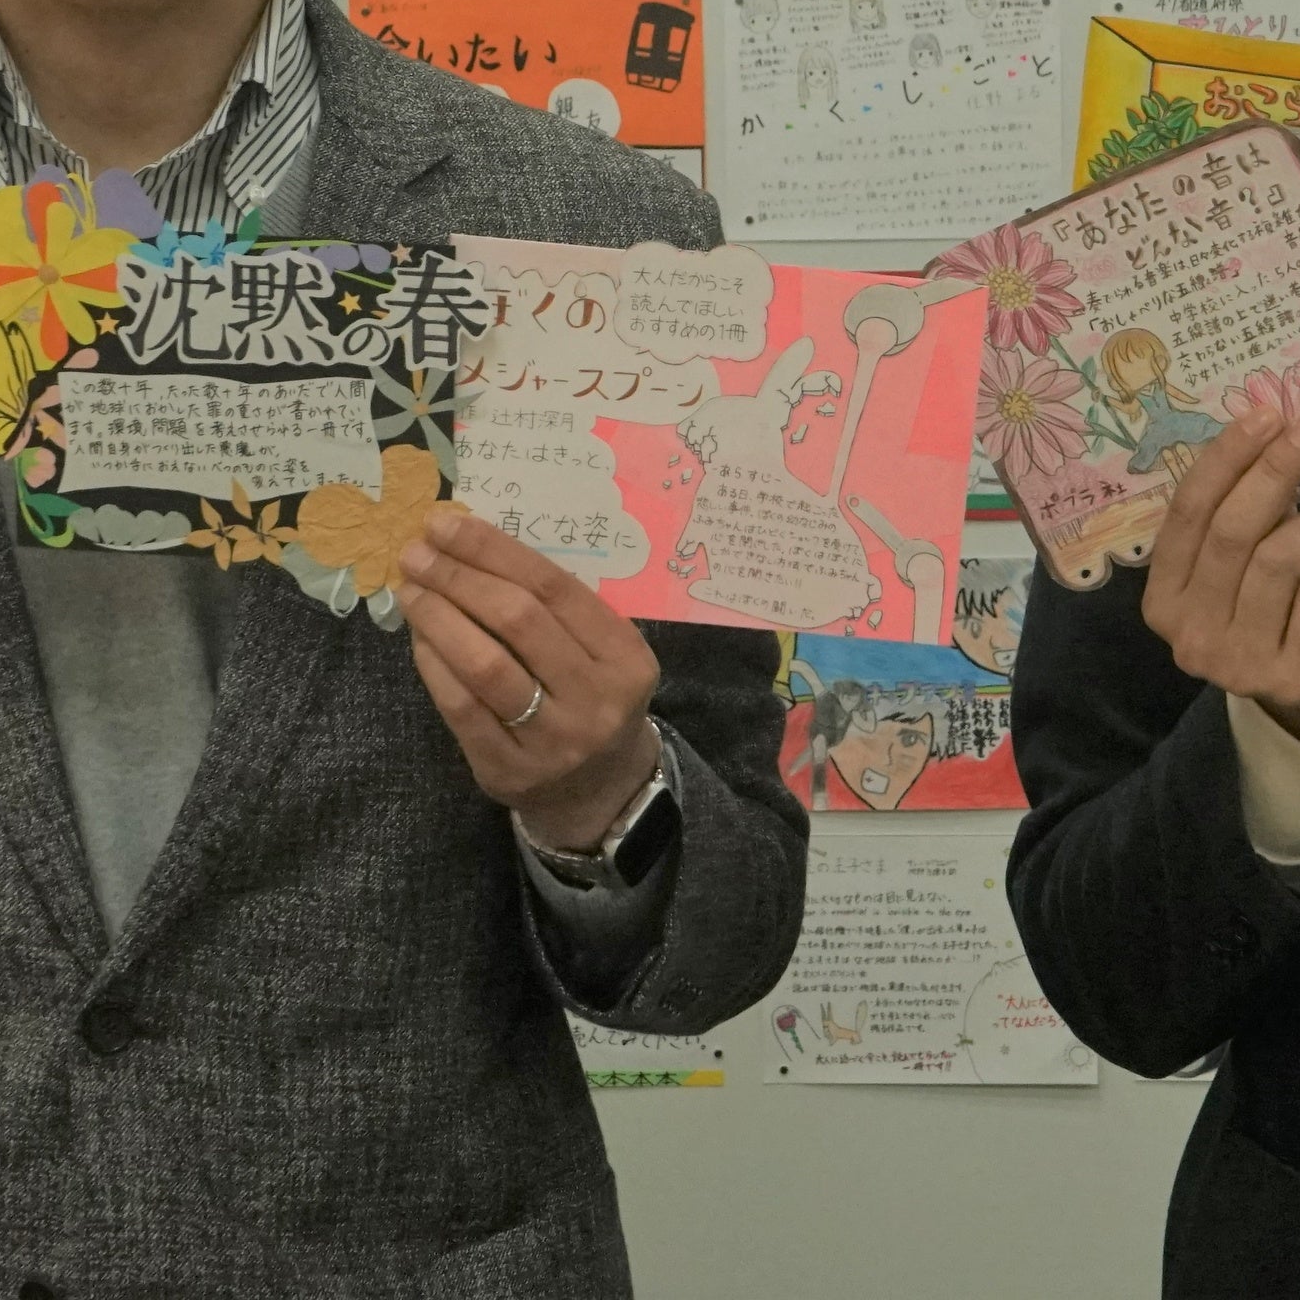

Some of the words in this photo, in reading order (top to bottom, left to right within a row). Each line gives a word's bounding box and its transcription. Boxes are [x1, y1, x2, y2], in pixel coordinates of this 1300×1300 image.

[118, 252, 490, 368] 沈黙の春
[629, 291, 746, 319] 読んでほしい
[628, 314, 749, 345] おすすめの1冊
[458, 355, 707, 409] メジャースプーン
[490, 408, 575, 436] 辻村深月
[454, 436, 612, 474] あなたはきっと、
[1036, 479, 1130, 523] ポプラ社
[805, 856, 889, 875] の王子さま
